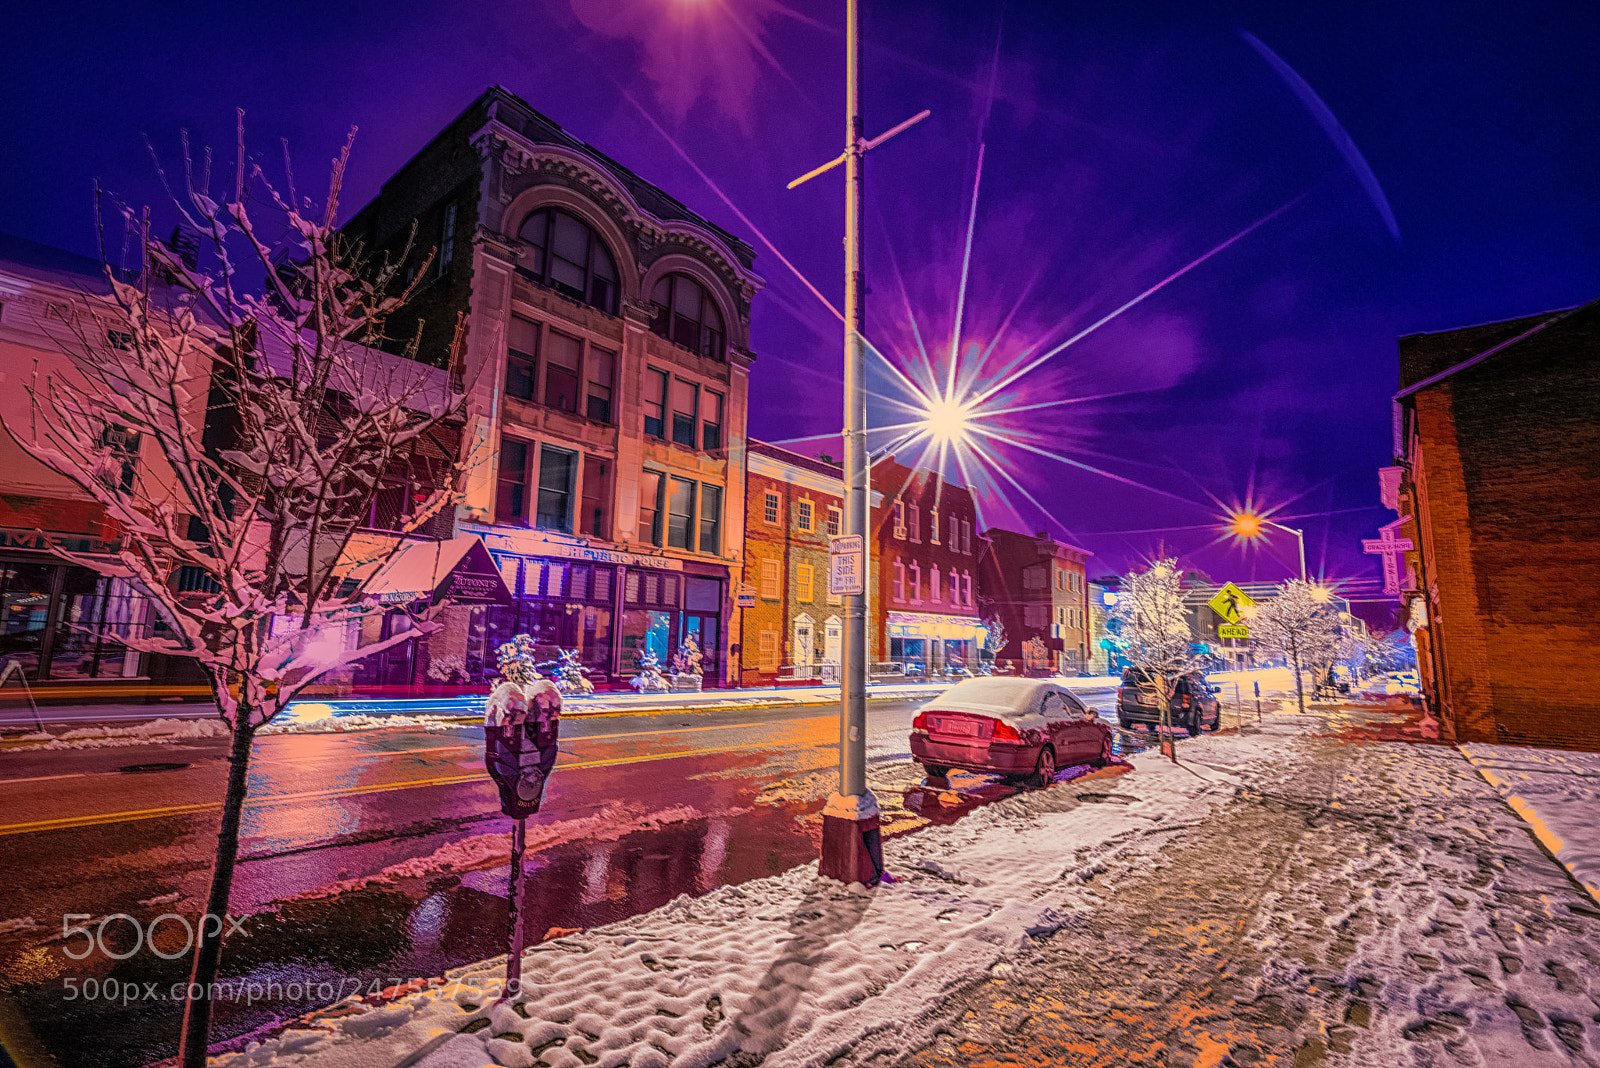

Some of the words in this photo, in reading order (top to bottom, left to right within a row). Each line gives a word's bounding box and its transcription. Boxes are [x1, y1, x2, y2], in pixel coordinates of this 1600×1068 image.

[583, 549, 628, 563] PUBLIC
[631, 555, 669, 569] HOUSE
[837, 555, 855, 565] THIS
[837, 566, 855, 575] SIDE
[1221, 628, 1247, 636] AHEAD
